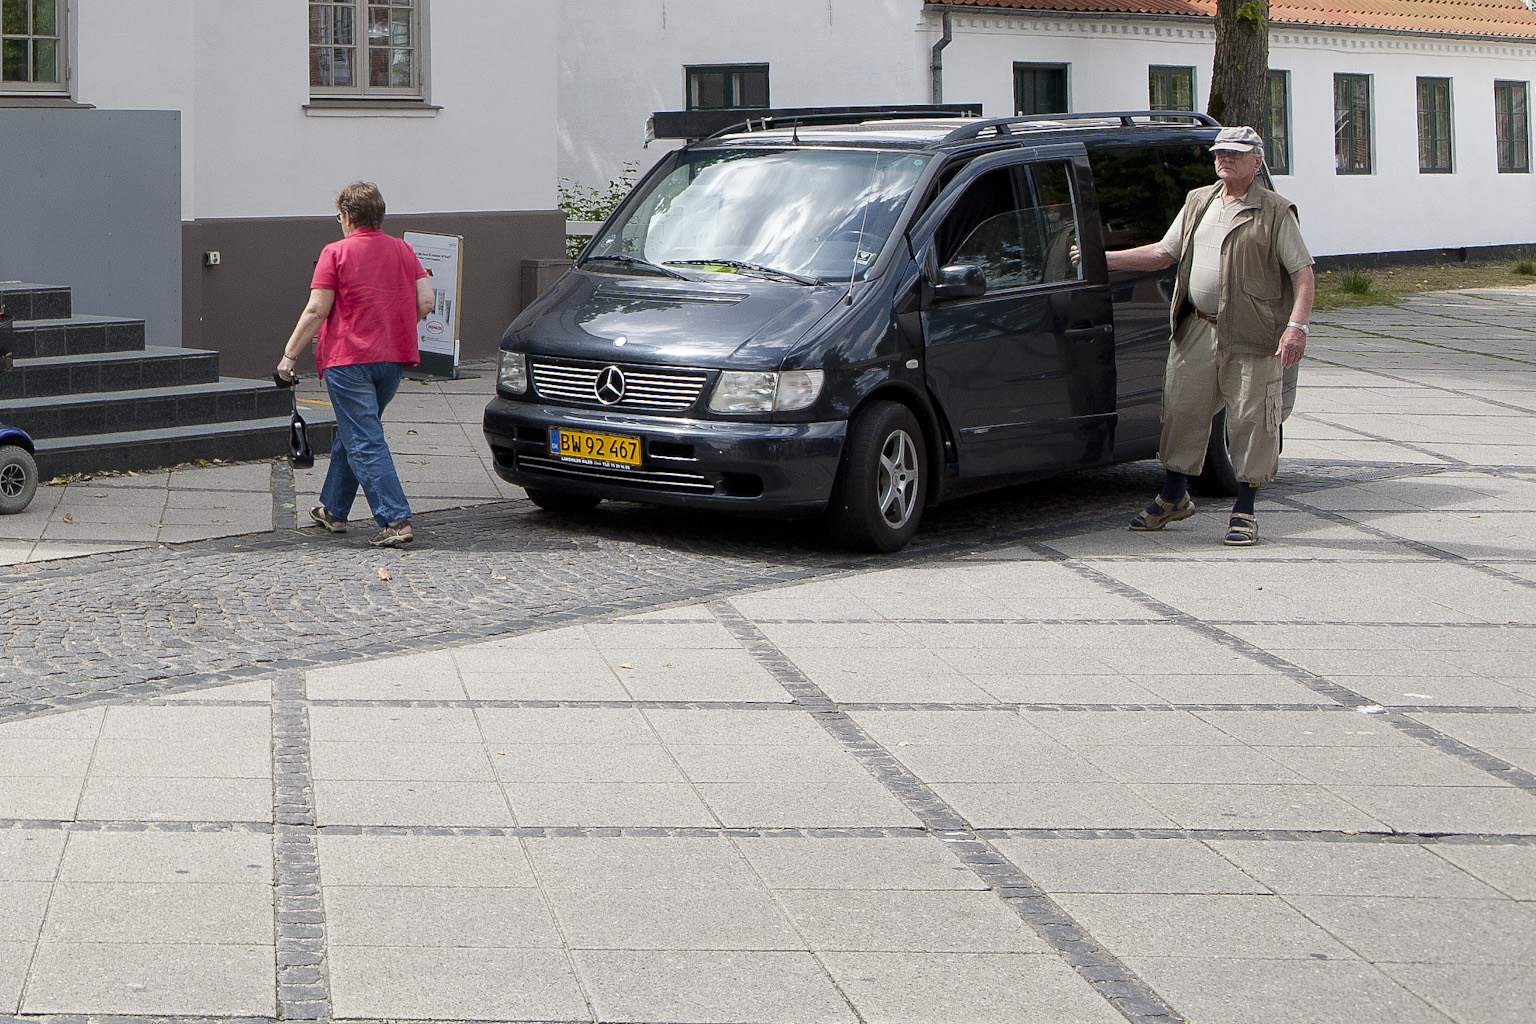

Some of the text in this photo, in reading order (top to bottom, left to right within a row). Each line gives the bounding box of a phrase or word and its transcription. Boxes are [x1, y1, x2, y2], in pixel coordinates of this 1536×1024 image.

[561, 434, 636, 459] BW 92 467
